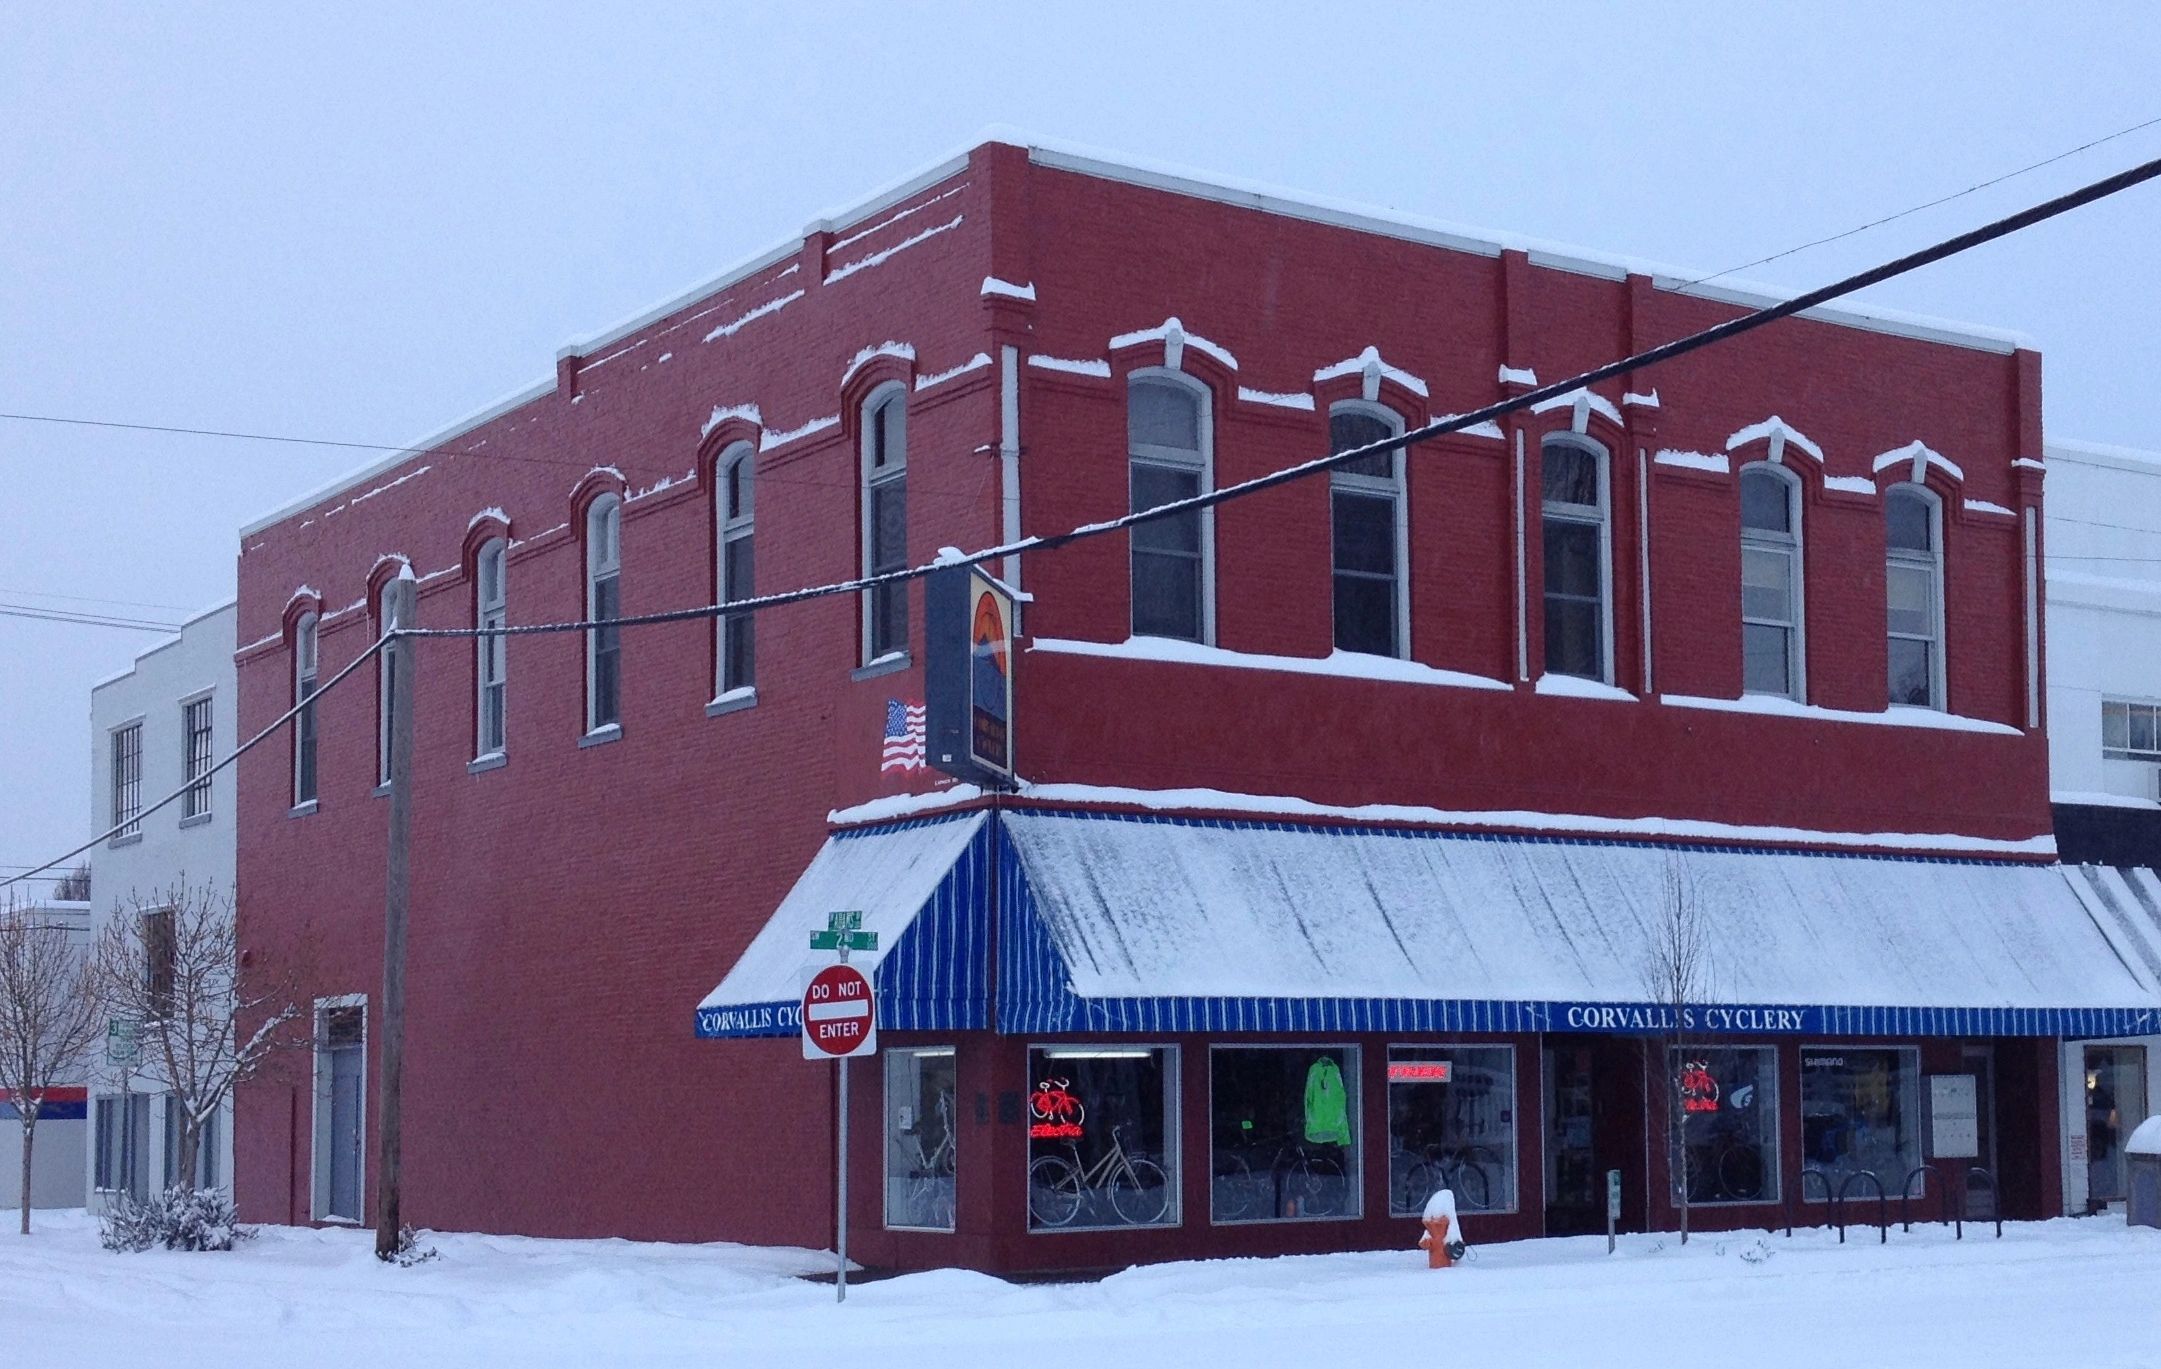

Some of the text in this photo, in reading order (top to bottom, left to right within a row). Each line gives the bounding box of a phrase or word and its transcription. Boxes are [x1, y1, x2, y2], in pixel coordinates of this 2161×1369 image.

[812, 980, 861, 999] DO NOT
[702, 1007, 772, 1032] CORVALLIS
[1706, 1008, 1805, 1030] CYCLERY
[819, 1021, 859, 1040] ENTER
